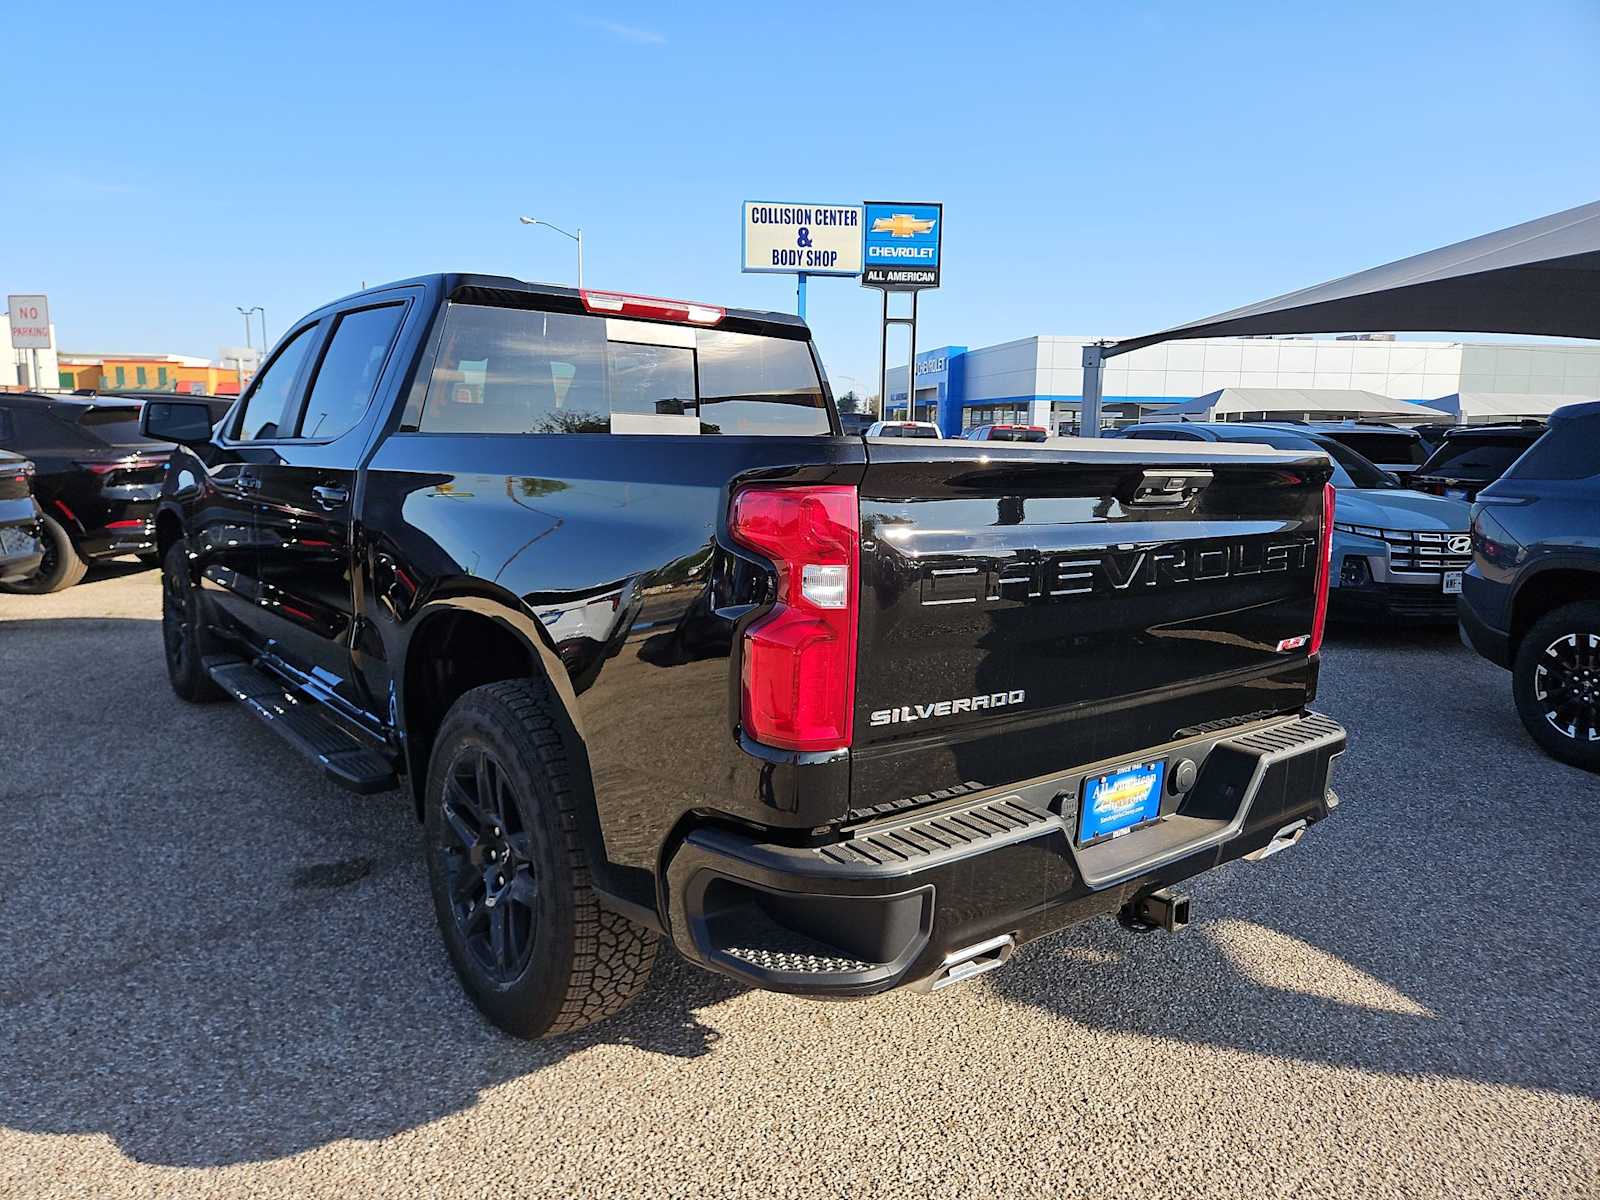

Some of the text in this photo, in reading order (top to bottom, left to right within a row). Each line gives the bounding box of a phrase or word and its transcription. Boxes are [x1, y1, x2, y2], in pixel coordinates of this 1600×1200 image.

[752, 207, 858, 226] COLLISION CENTER
[797, 227, 813, 248] &
[772, 249, 838, 267] BODY SHOP
[869, 246, 935, 258] CHEVROLET
[867, 270, 936, 282] ALL AMERICAN
[19, 306, 38, 319] NO
[12, 327, 48, 337] PARKING
[921, 538, 1315, 606] CHEVROLET
[869, 689, 1026, 727] SILVERADO
